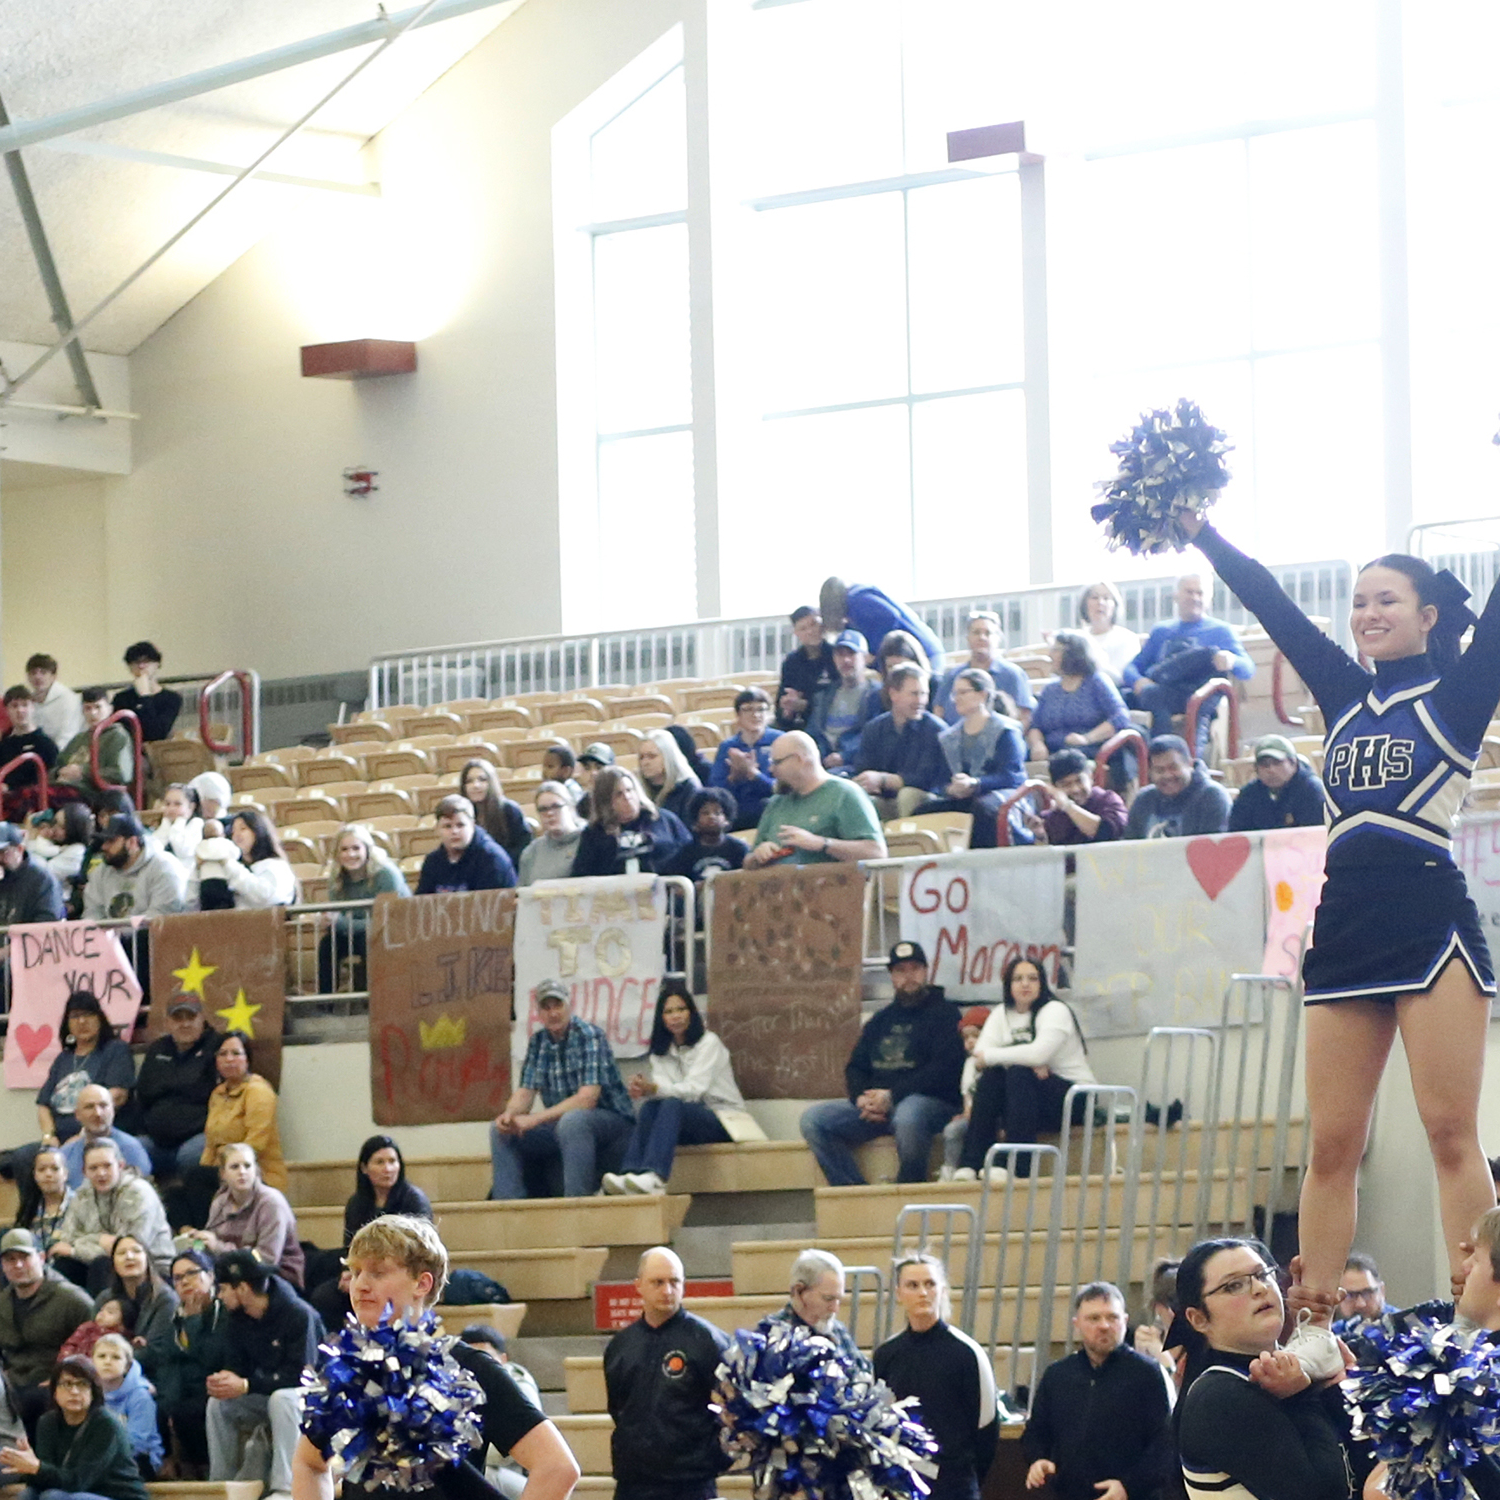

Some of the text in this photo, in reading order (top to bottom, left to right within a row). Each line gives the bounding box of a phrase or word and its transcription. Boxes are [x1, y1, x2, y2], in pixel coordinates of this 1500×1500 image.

[1329, 733, 1415, 791] PHS
[383, 891, 516, 949] LOOKING
[21, 926, 100, 968] DANCE
[547, 925, 632, 977] TO
[64, 969, 132, 1002] YOUR
